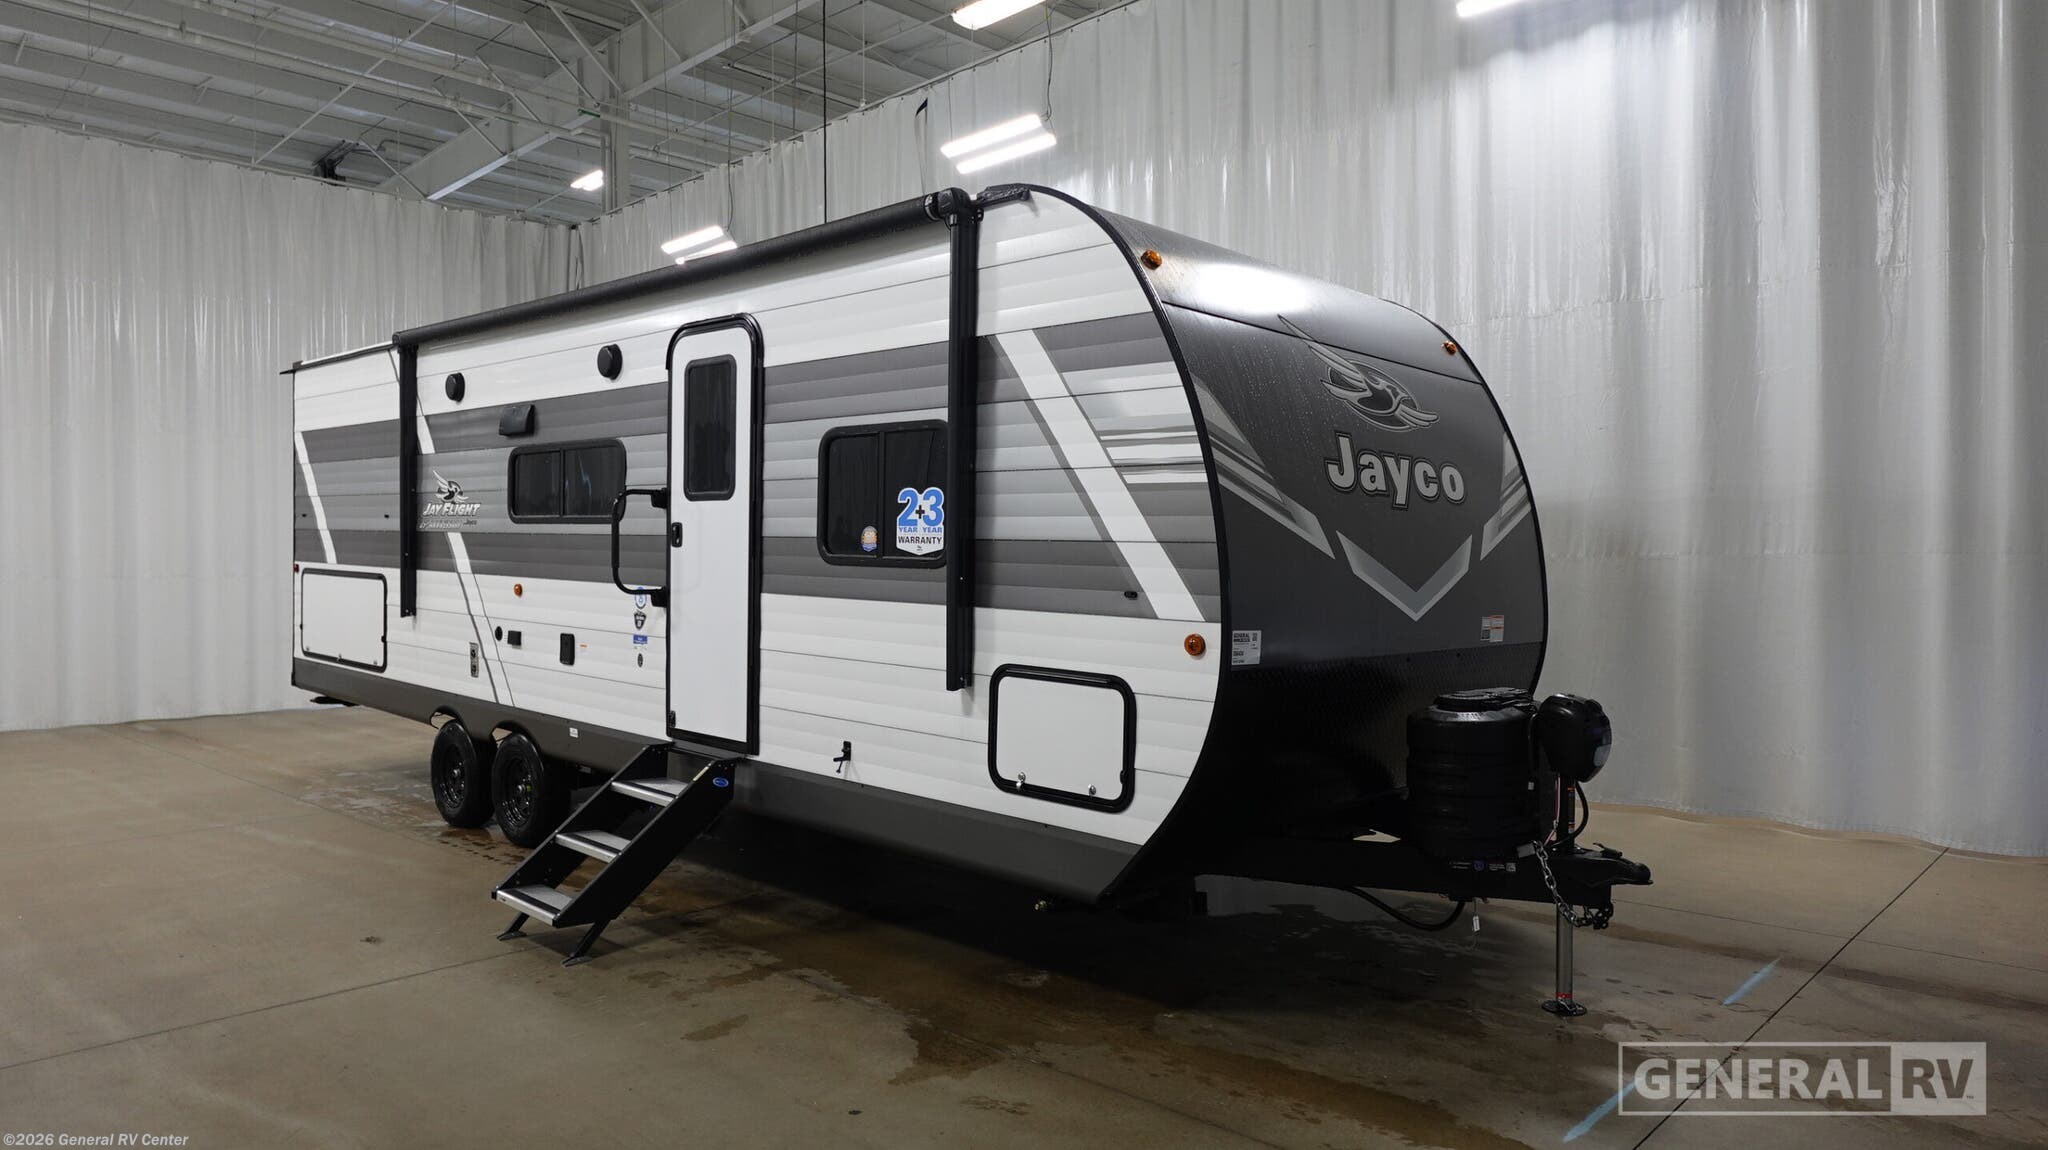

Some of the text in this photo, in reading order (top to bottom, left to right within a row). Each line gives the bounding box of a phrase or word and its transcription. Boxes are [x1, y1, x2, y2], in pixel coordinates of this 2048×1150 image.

[1324, 432, 1466, 509] Jayco
[422, 502, 481, 516] JAY FLIGHT
[898, 536, 942, 544] WARRANTY
